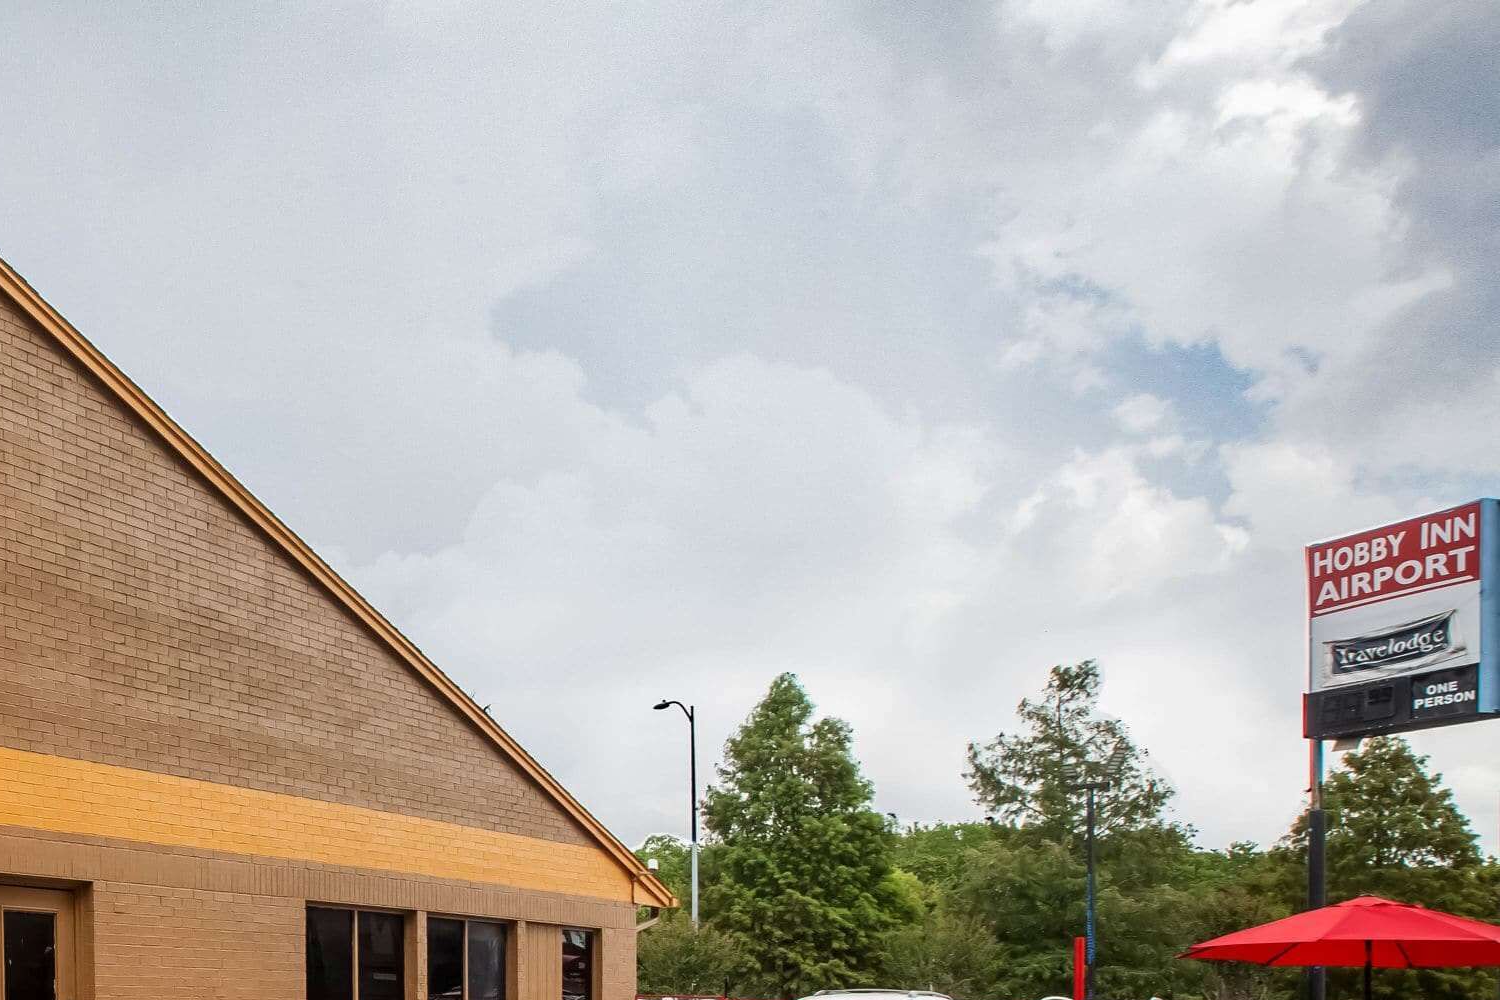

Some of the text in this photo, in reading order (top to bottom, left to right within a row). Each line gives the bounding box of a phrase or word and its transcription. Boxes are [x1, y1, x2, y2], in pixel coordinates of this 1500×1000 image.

[1313, 513, 1476, 578] HOBBY INN
[1315, 545, 1476, 606] AIRPORT
[1413, 690, 1476, 710] PERSON
[1426, 680, 1459, 696] ONE
